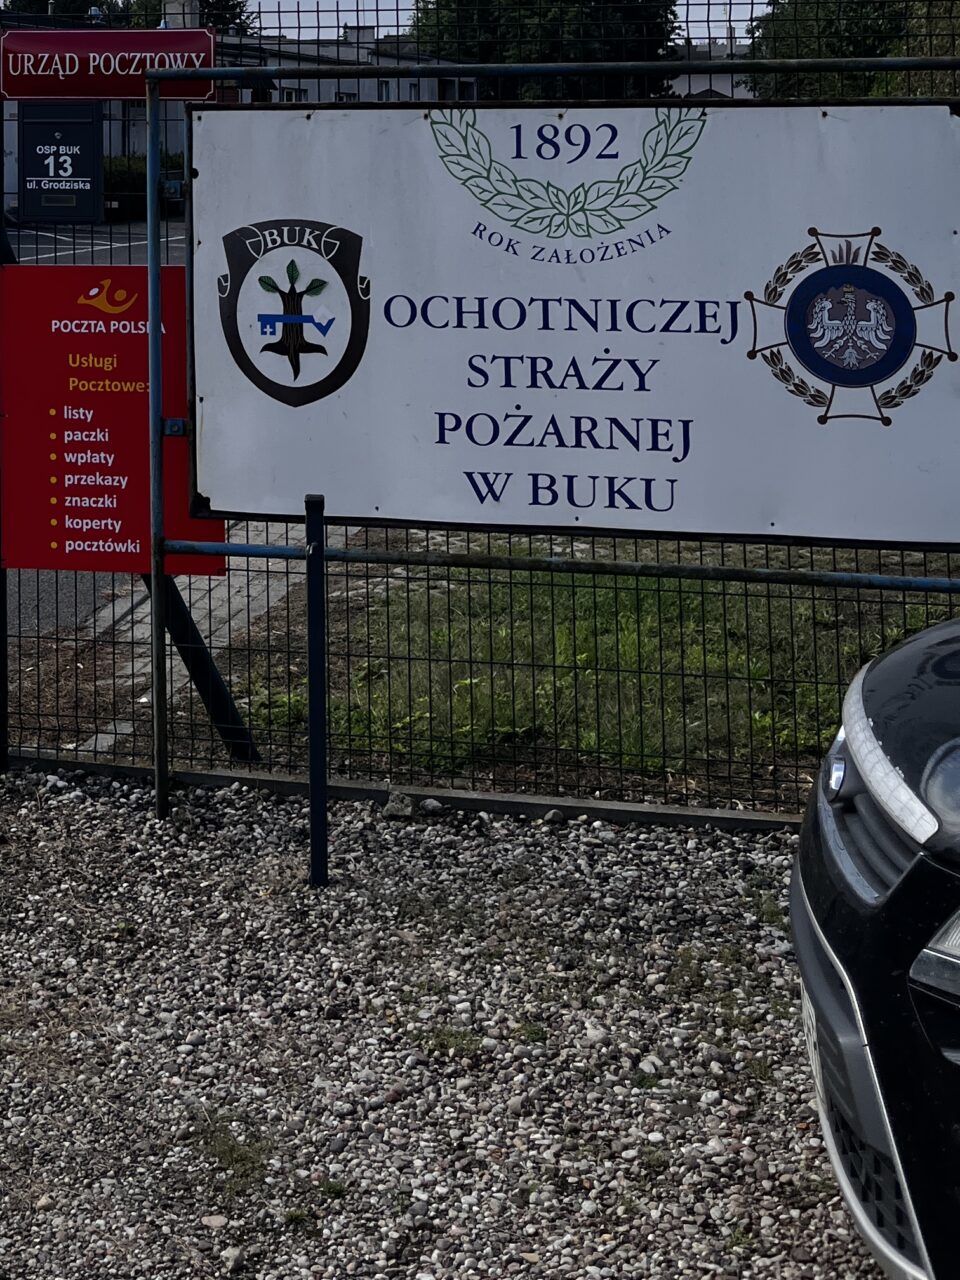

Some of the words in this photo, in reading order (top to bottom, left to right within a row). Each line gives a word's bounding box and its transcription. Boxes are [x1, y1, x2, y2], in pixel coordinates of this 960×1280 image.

[8, 53, 78, 79] URZĄD
[89, 53, 205, 75] POCZTOWY
[36, 146, 56, 154] OSP
[59, 146, 80, 154] BUK
[509, 123, 619, 164] 1892
[44, 156, 72, 177] 13
[26, 181, 38, 189] ul.
[41, 180, 90, 190] Grodziska
[262, 227, 321, 249] BUK
[471, 221, 521, 256] ROK
[530, 223, 672, 264] ZAŁOŻENIA
[51, 320, 106, 333] POCZTA
[110, 321, 166, 334] POLS
[383, 294, 741, 344] OCHOTNICZEJ
[68, 353, 117, 370] Usługi
[467, 348, 660, 393] STRAŻY
[68, 377, 150, 393] Pocztowe:
[64, 406, 93, 422] listy
[64, 428, 109, 445] paczki
[434, 404, 694, 463] POŻARNEJ
[64, 450, 114, 466] wpłaty
[64, 471, 128, 489] przekazy
[64, 494, 117, 508] znaczki
[464, 472, 513, 506] W
[528, 474, 679, 513] BUKU
[65, 515, 122, 533] koperty
[65, 538, 140, 554] pocztówki
